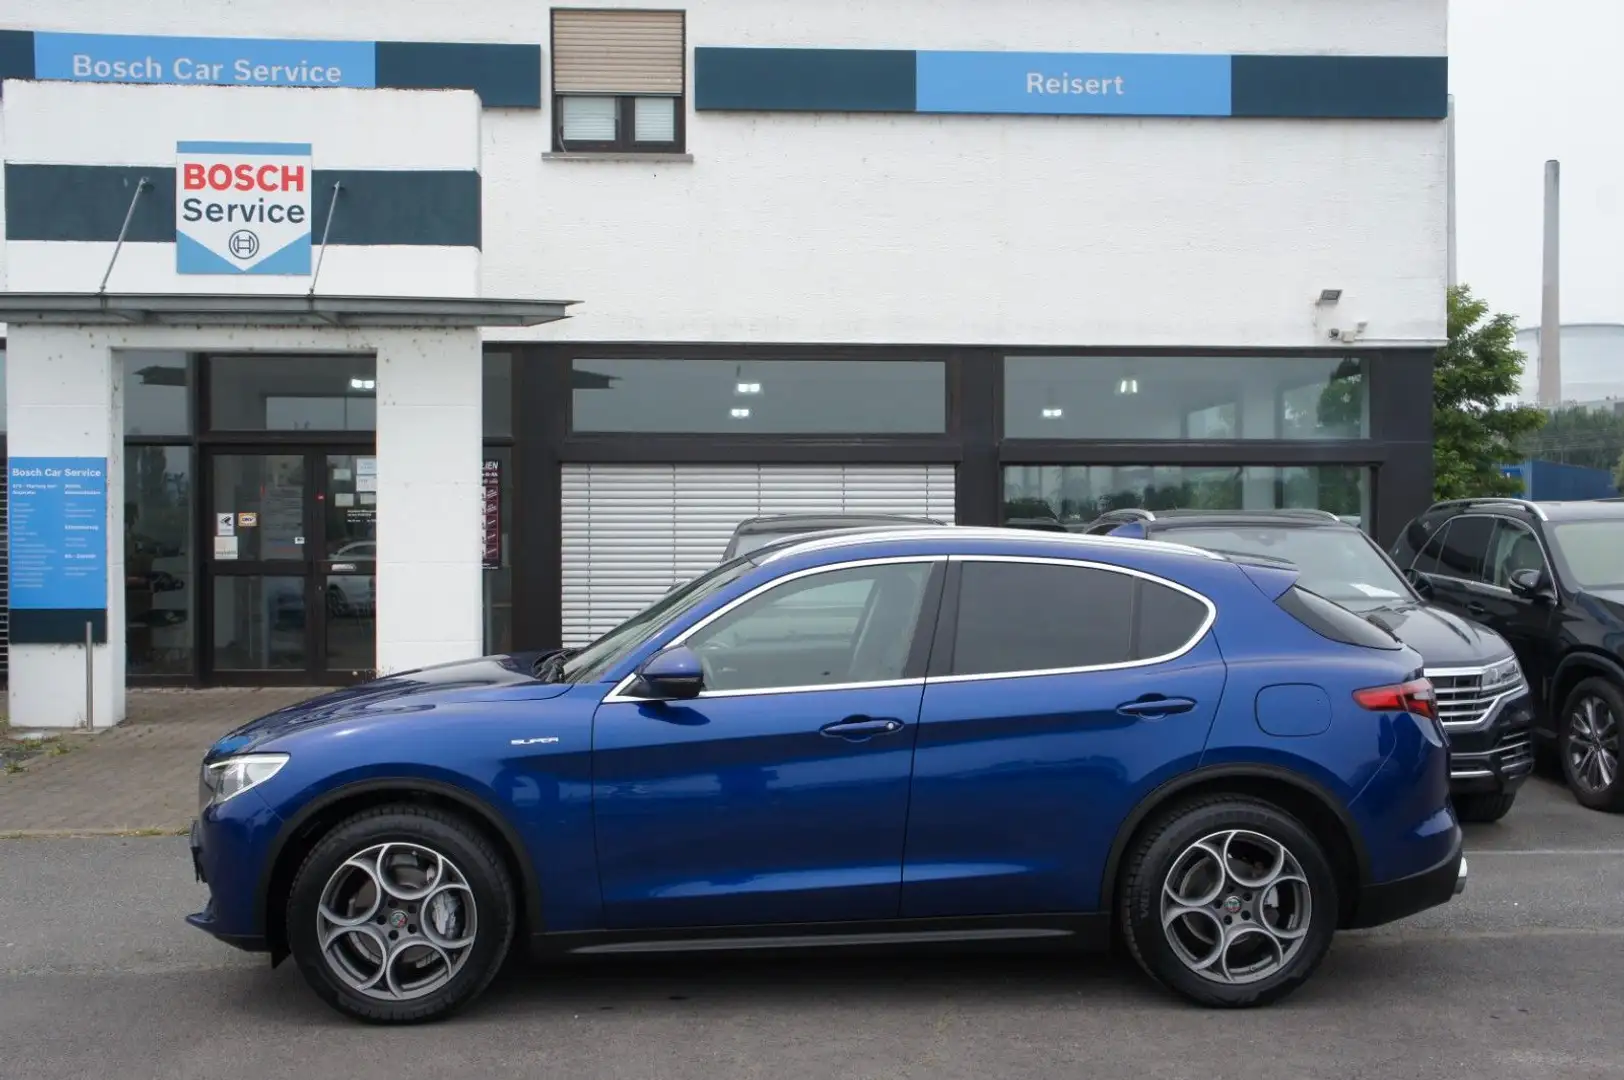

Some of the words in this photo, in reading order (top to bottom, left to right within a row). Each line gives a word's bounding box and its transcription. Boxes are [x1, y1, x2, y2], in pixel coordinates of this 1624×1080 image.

[73, 54, 162, 79] Bosch
[174, 57, 223, 81] Car
[234, 59, 341, 82] Service
[1026, 72, 1124, 95] Reisert
[184, 163, 304, 192] BOSCH
[183, 197, 305, 224] Service
[12, 468, 42, 477] Bosch
[44, 468, 62, 477] Car
[64, 468, 102, 477] Service
